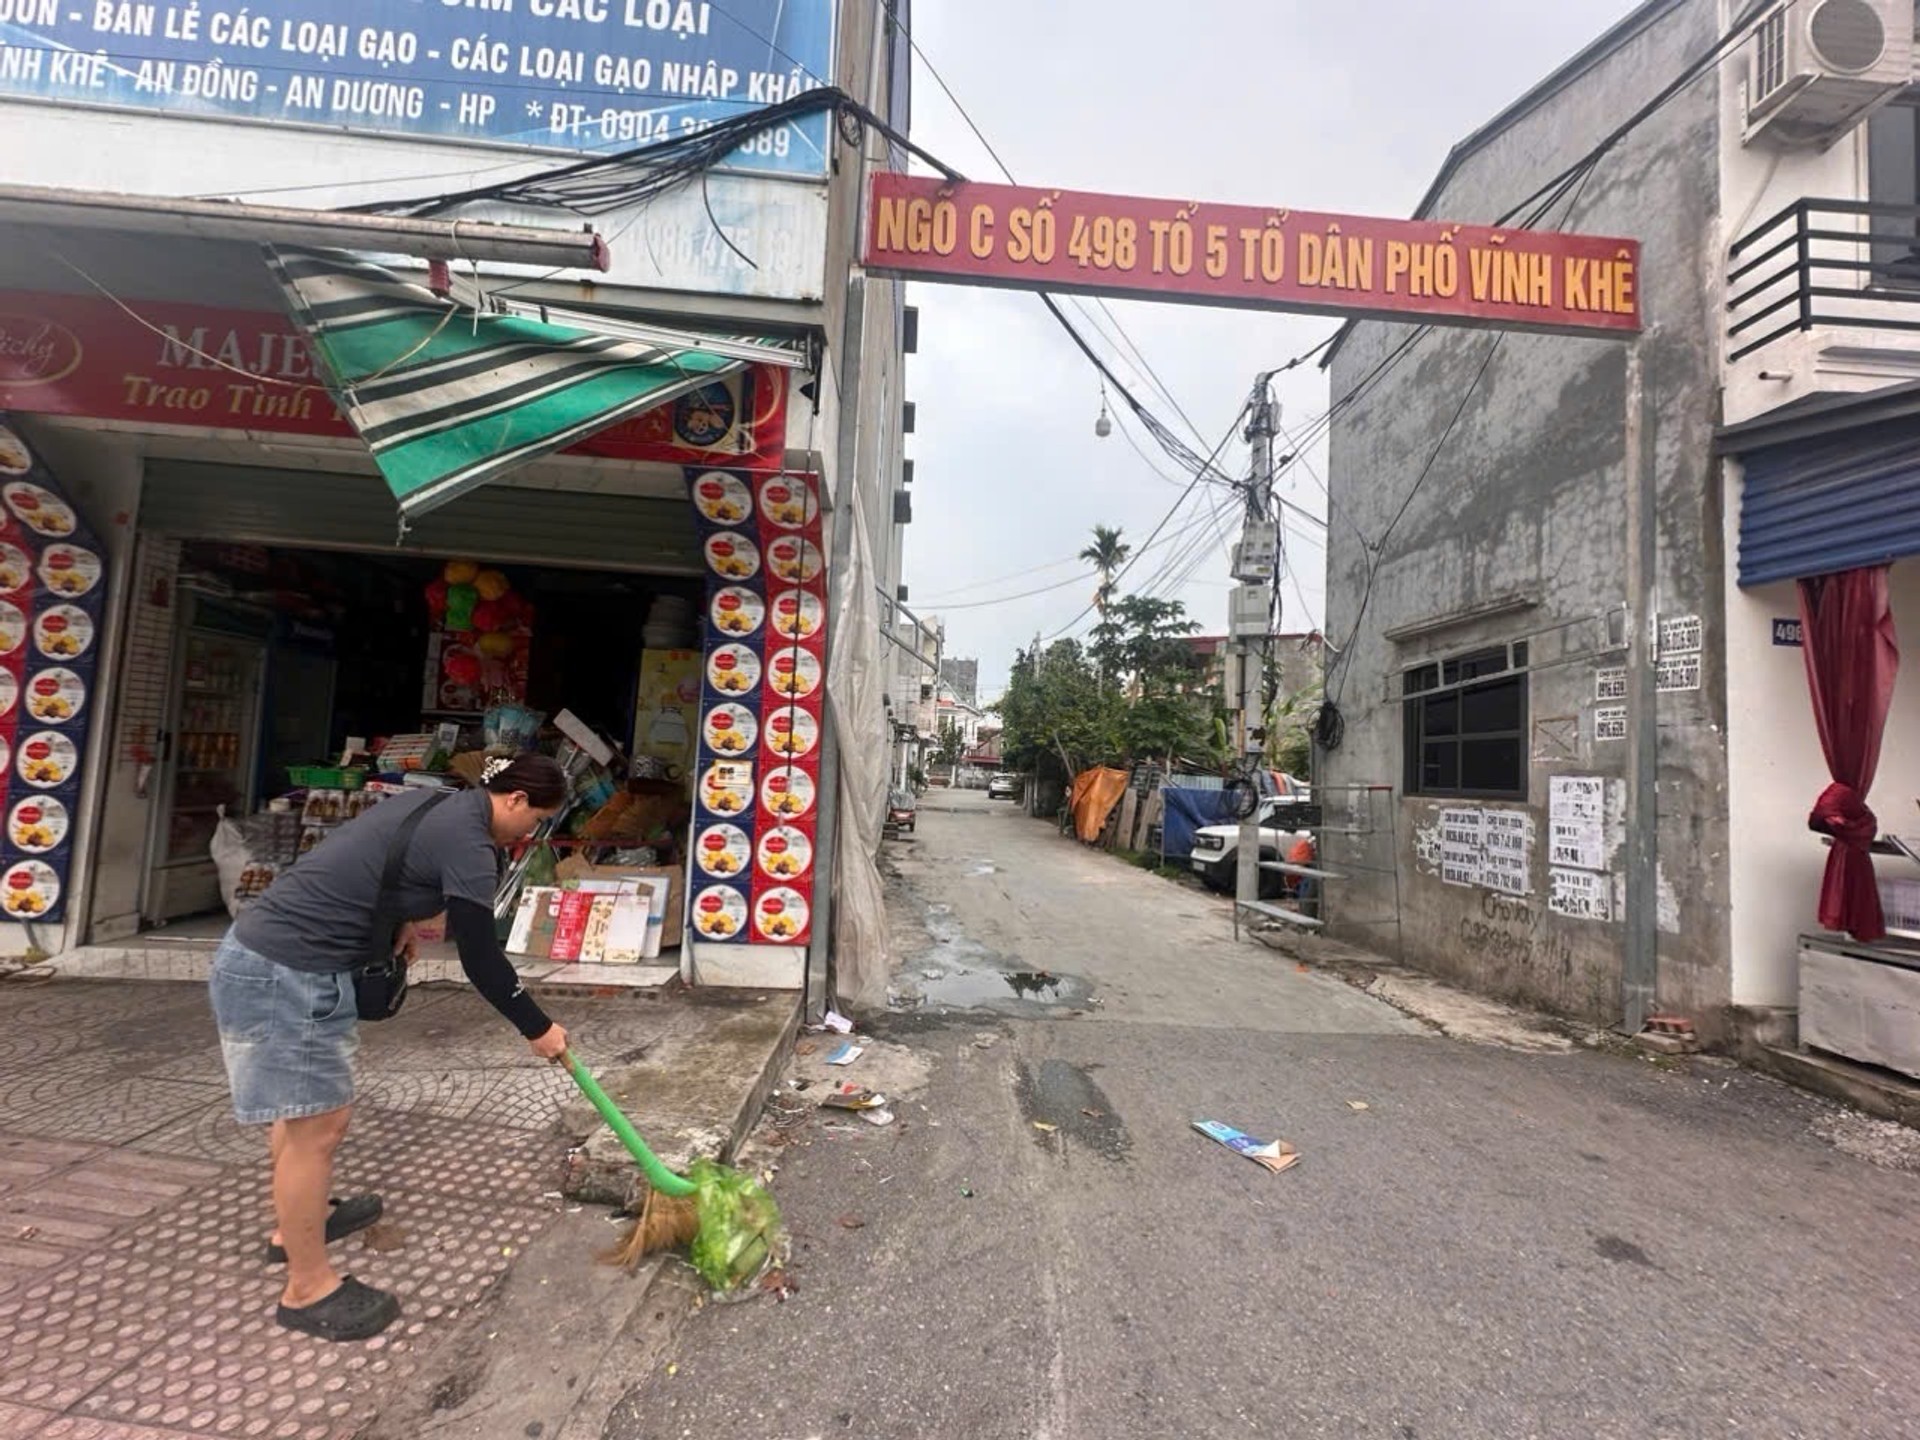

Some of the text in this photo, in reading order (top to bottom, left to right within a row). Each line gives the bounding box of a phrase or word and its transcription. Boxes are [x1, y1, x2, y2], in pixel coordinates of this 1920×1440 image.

[623, 0, 710, 39] LOẠI
[164, 2, 201, 41] LẺ
[210, 8, 271, 48] CÁC
[281, 26, 348, 63] LOẠI
[358, 28, 418, 68] GẠO
[451, 34, 508, 73] CÁC
[519, 46, 584, 88] LOẠI
[595, 56, 651, 94] GẠO
[661, 59, 739, 103] NHẬP
[50, 49, 109, 87] KHÊ
[135, 60, 174, 94] AN
[183, 58, 258, 102] ĐỒNG
[285, 75, 323, 110] AN
[332, 79, 424, 118] DƯƠNG
[458, 92, 497, 126] HP
[877, 189, 957, 256] NGÕ
[970, 204, 994, 259] C
[1007, 190, 1062, 264] SỐ
[1068, 215, 1137, 271] 498
[1149, 201, 1199, 276] TỔ
[1206, 225, 1228, 279] 5
[1239, 208, 1289, 284] TỔ
[1299, 222, 1373, 291] DÂN
[1386, 225, 1461, 298] PHỐ
[1470, 235, 1552, 307] VĨNH
[1564, 248, 1634, 314] KHÊ
[157, 324, 321, 378] MAJE
[123, 373, 210, 411] Trao
[228, 383, 311, 420] Tình
